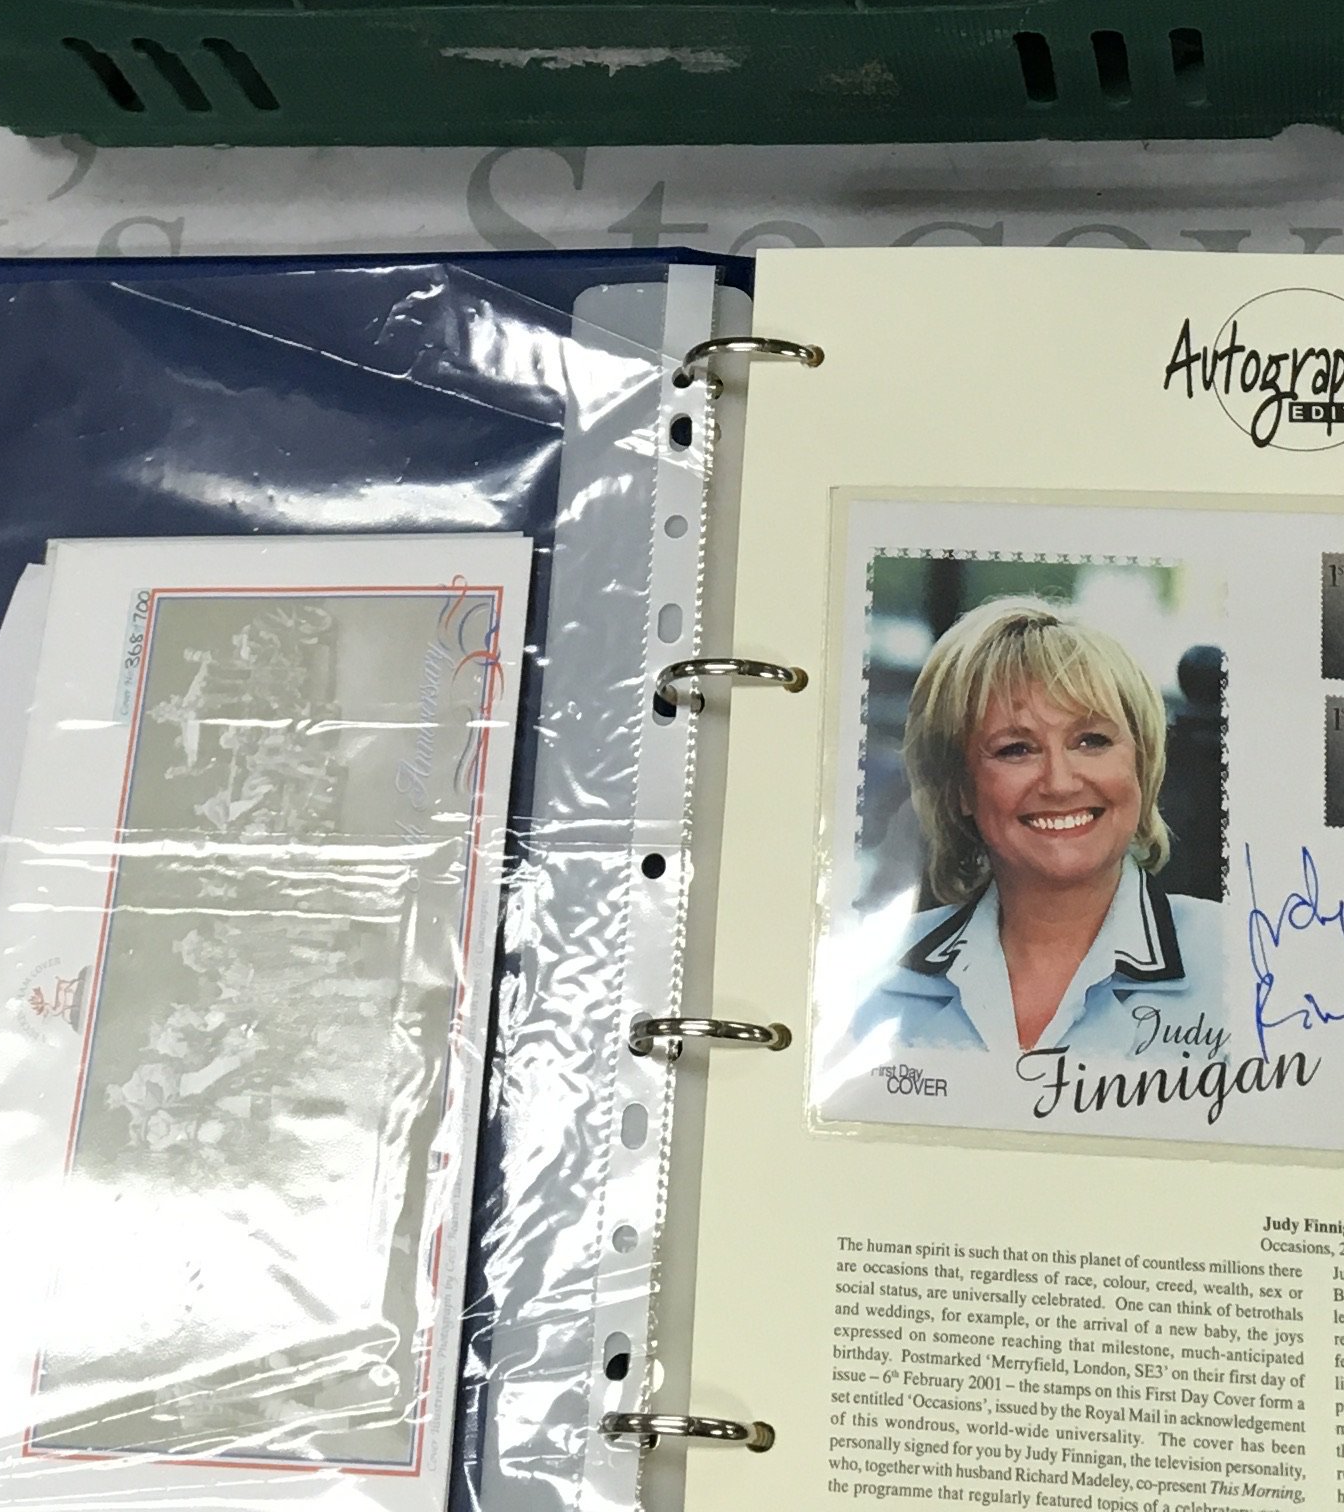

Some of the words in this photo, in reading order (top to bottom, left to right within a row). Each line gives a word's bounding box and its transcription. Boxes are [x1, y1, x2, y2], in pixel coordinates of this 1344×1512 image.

[132, 590, 150, 622] 700
[124, 633, 144, 670] 368
[1131, 1005, 1233, 1059] Judy
[886, 1075, 948, 1097] COVER
[899, 1064, 924, 1082] Day
[1016, 1045, 1322, 1124] Finnigan
[1262, 1216, 1300, 1236] Judy
[836, 1235, 864, 1252] The
[866, 1237, 913, 1256] human
[915, 1241, 951, 1260] spirit
[953, 1242, 966, 1259] is
[967, 1245, 1000, 1261] such
[1002, 1246, 1029, 1263] that
[1030, 1250, 1049, 1263] on
[1052, 1249, 1077, 1265] this
[1079, 1251, 1122, 1270] planet
[1124, 1253, 1141, 1269] of
[1141, 1256, 1207, 1273] countless
[1208, 1258, 1266, 1277] millions
[1268, 1262, 1303, 1279] there
[1260, 1236, 1336, 1257] Occasions,
[836, 1261, 857, 1273] are
[862, 1260, 929, 1278] occasions
[934, 1262, 965, 1282] that,
[969, 1267, 1039, 1285] regardless
[1043, 1270, 1061, 1286] of
[1064, 1274, 1098, 1290] race,
[1102, 1274, 1151, 1294] colour,
[1155, 1278, 1198, 1296] creed,
[1202, 1281, 1254, 1299] wealth,
[1258, 1286, 1283, 1299] sex
[1288, 1288, 1304, 1300] or
[835, 1279, 875, 1296] social
[879, 1283, 923, 1301] status,
[926, 1287, 948, 1301] are
[951, 1285, 1028, 1309] universally
[1031, 1291, 1106, 1310] celebrated.
[1114, 1295, 1144, 1312] One
[1147, 1301, 1172, 1314] can
[1176, 1299, 1213, 1317] think
[1216, 1302, 1233, 1318] of
[1234, 1303, 1304, 1322] betrothals
